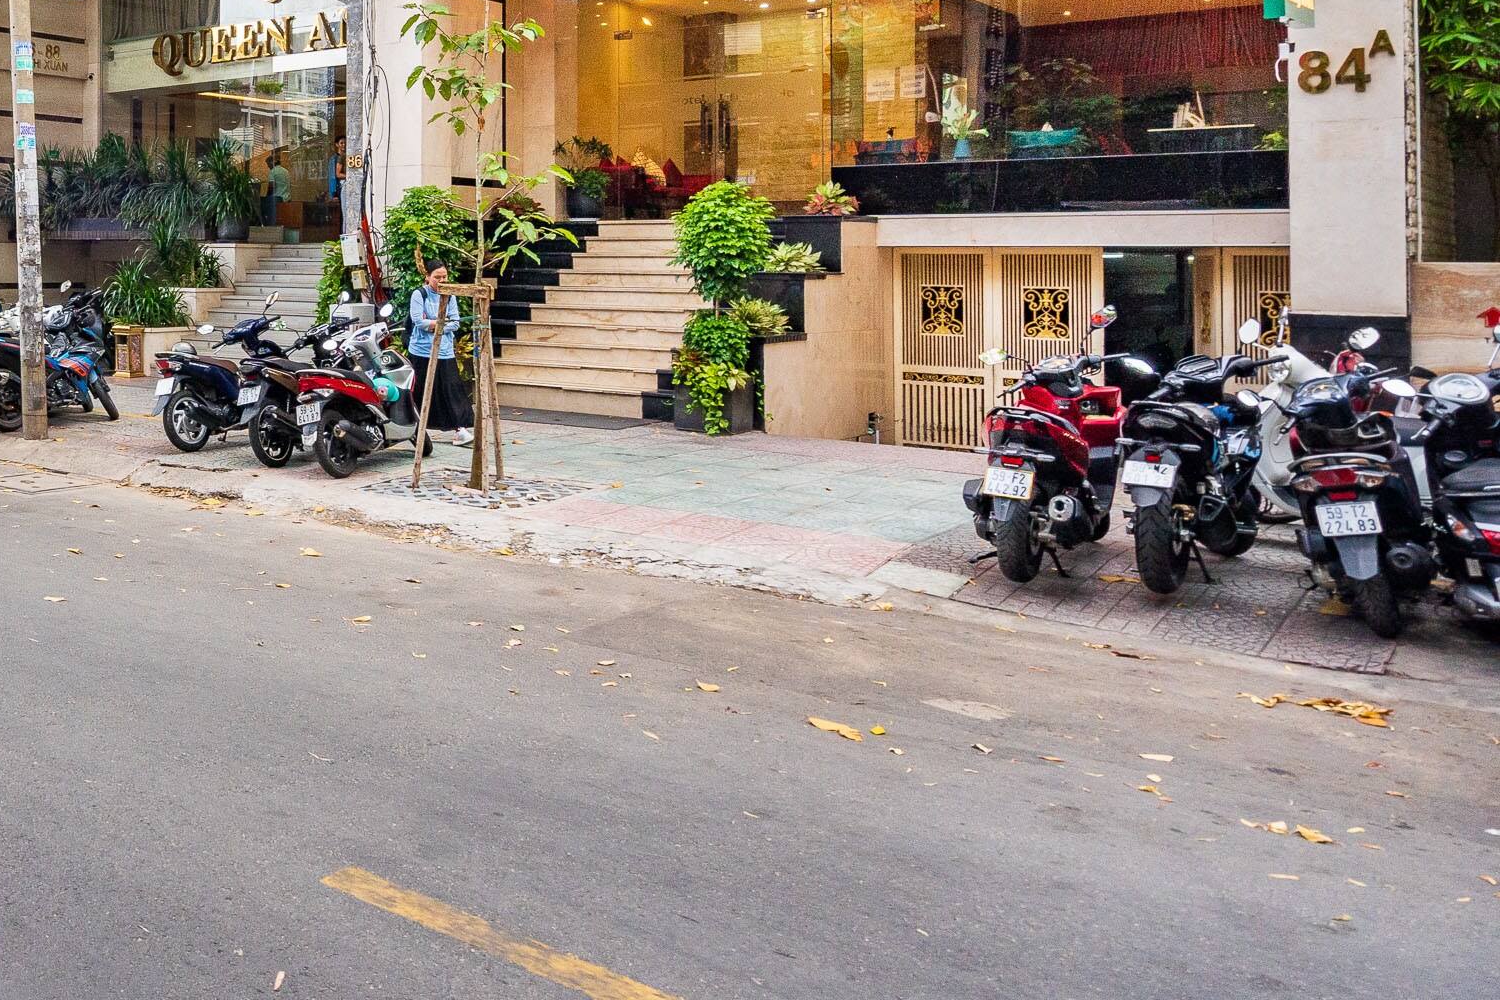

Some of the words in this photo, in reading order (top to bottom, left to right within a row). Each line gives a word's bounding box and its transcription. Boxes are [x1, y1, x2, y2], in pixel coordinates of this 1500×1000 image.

[152, 14, 295, 77] QUEEN
[346, 154, 363, 168] 86
[992, 469, 1026, 485] 59-F2
[1325, 504, 1369, 520] 59-T2
[1324, 518, 1378, 534] 224.83
